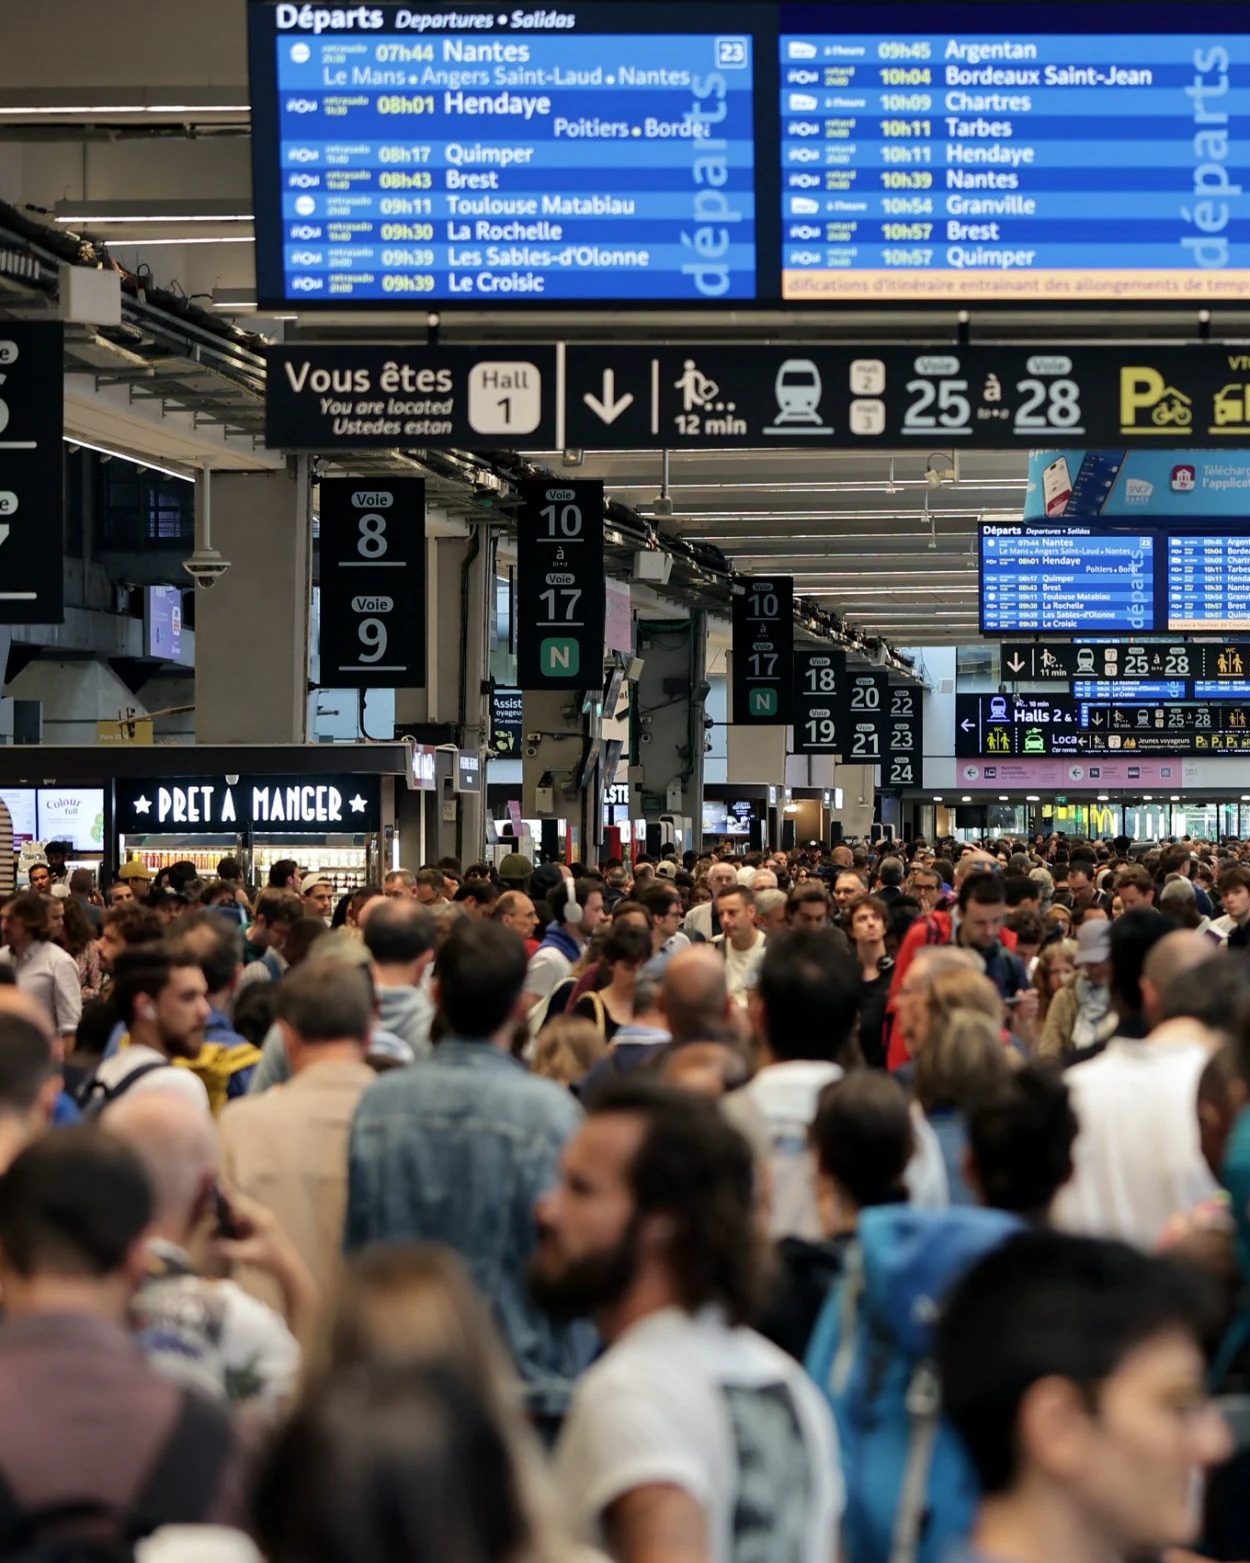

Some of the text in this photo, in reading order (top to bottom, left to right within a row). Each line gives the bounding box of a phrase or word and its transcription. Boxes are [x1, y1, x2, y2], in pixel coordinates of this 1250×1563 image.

[276, 4, 575, 34] Départs Departures Salidas
[376, 44, 434, 62] 07h44
[443, 40, 530, 62] Nantes
[720, 43, 744, 62] 23
[945, 40, 1037, 63] Argentan
[323, 66, 690, 89] Le Mans Angers Saint-Laud Nantes
[946, 65, 1152, 85] Bordeaux Saint-Jean
[377, 95, 434, 114] 08h01
[444, 91, 551, 120] Hendaye
[945, 91, 1031, 111] Chartres
[554, 118, 629, 137] Poitiers
[945, 118, 1012, 137] Tarbes
[378, 144, 534, 166] 08h17 Quimper
[946, 144, 1034, 167] Hendaye
[1180, 45, 1242, 268] départs
[379, 169, 498, 189] 08h43 Brest
[681, 72, 742, 296] départs
[947, 170, 1018, 189] Nantes
[380, 195, 635, 215] 09h11 Toulouse Matabiau
[946, 195, 1036, 215] Granville
[380, 221, 562, 241] 09h30 La Rochelle
[947, 220, 999, 240] Brest
[381, 247, 649, 266] 09h39 Les Sables-d'Olonne
[947, 247, 1035, 269] Quimper
[382, 273, 544, 292] 09h39 Le Croisic
[285, 360, 453, 393] Vous êtes
[482, 370, 529, 390] Hall
[904, 374, 1080, 426] 25 à 28
[1120, 366, 1165, 425] P
[320, 398, 453, 415] You are located
[497, 398, 510, 424] 1
[333, 418, 452, 435] Ustedes estan
[675, 416, 747, 435] 12 min
[357, 495, 388, 506] Voie
[550, 490, 571, 500] Voie
[539, 505, 582, 536] 10
[983, 525, 1090, 536] Départs Departures Salidas
[357, 514, 387, 558] 8
[1042, 538, 1073, 547] Nantes
[556, 546, 564, 560] à
[1043, 557, 1080, 566] Hendaye
[550, 574, 571, 584] Voie
[357, 599, 388, 611] Voie
[539, 589, 582, 620] 17
[748, 594, 778, 616] 10
[358, 619, 387, 663] 9
[550, 646, 569, 668] N
[748, 653, 778, 676] 17
[1124, 656, 1189, 673] 25 28
[805, 668, 835, 691] 18
[1040, 668, 1067, 677] 11 min
[756, 694, 770, 709] N
[851, 688, 879, 707] 20
[891, 698, 913, 714] 22
[1014, 710, 1062, 723] Halls 2
[805, 720, 835, 742] 19
[891, 731, 913, 747] 23
[852, 734, 879, 753] 21
[1138, 737, 1158, 745] Jeunes
[1160, 737, 1190, 746] voyageurs
[891, 765, 913, 780] 24
[46, 798, 81, 809] Colour
[65, 808, 78, 816] full
[159, 786, 214, 822] PRET
[253, 786, 342, 821] MANGER
